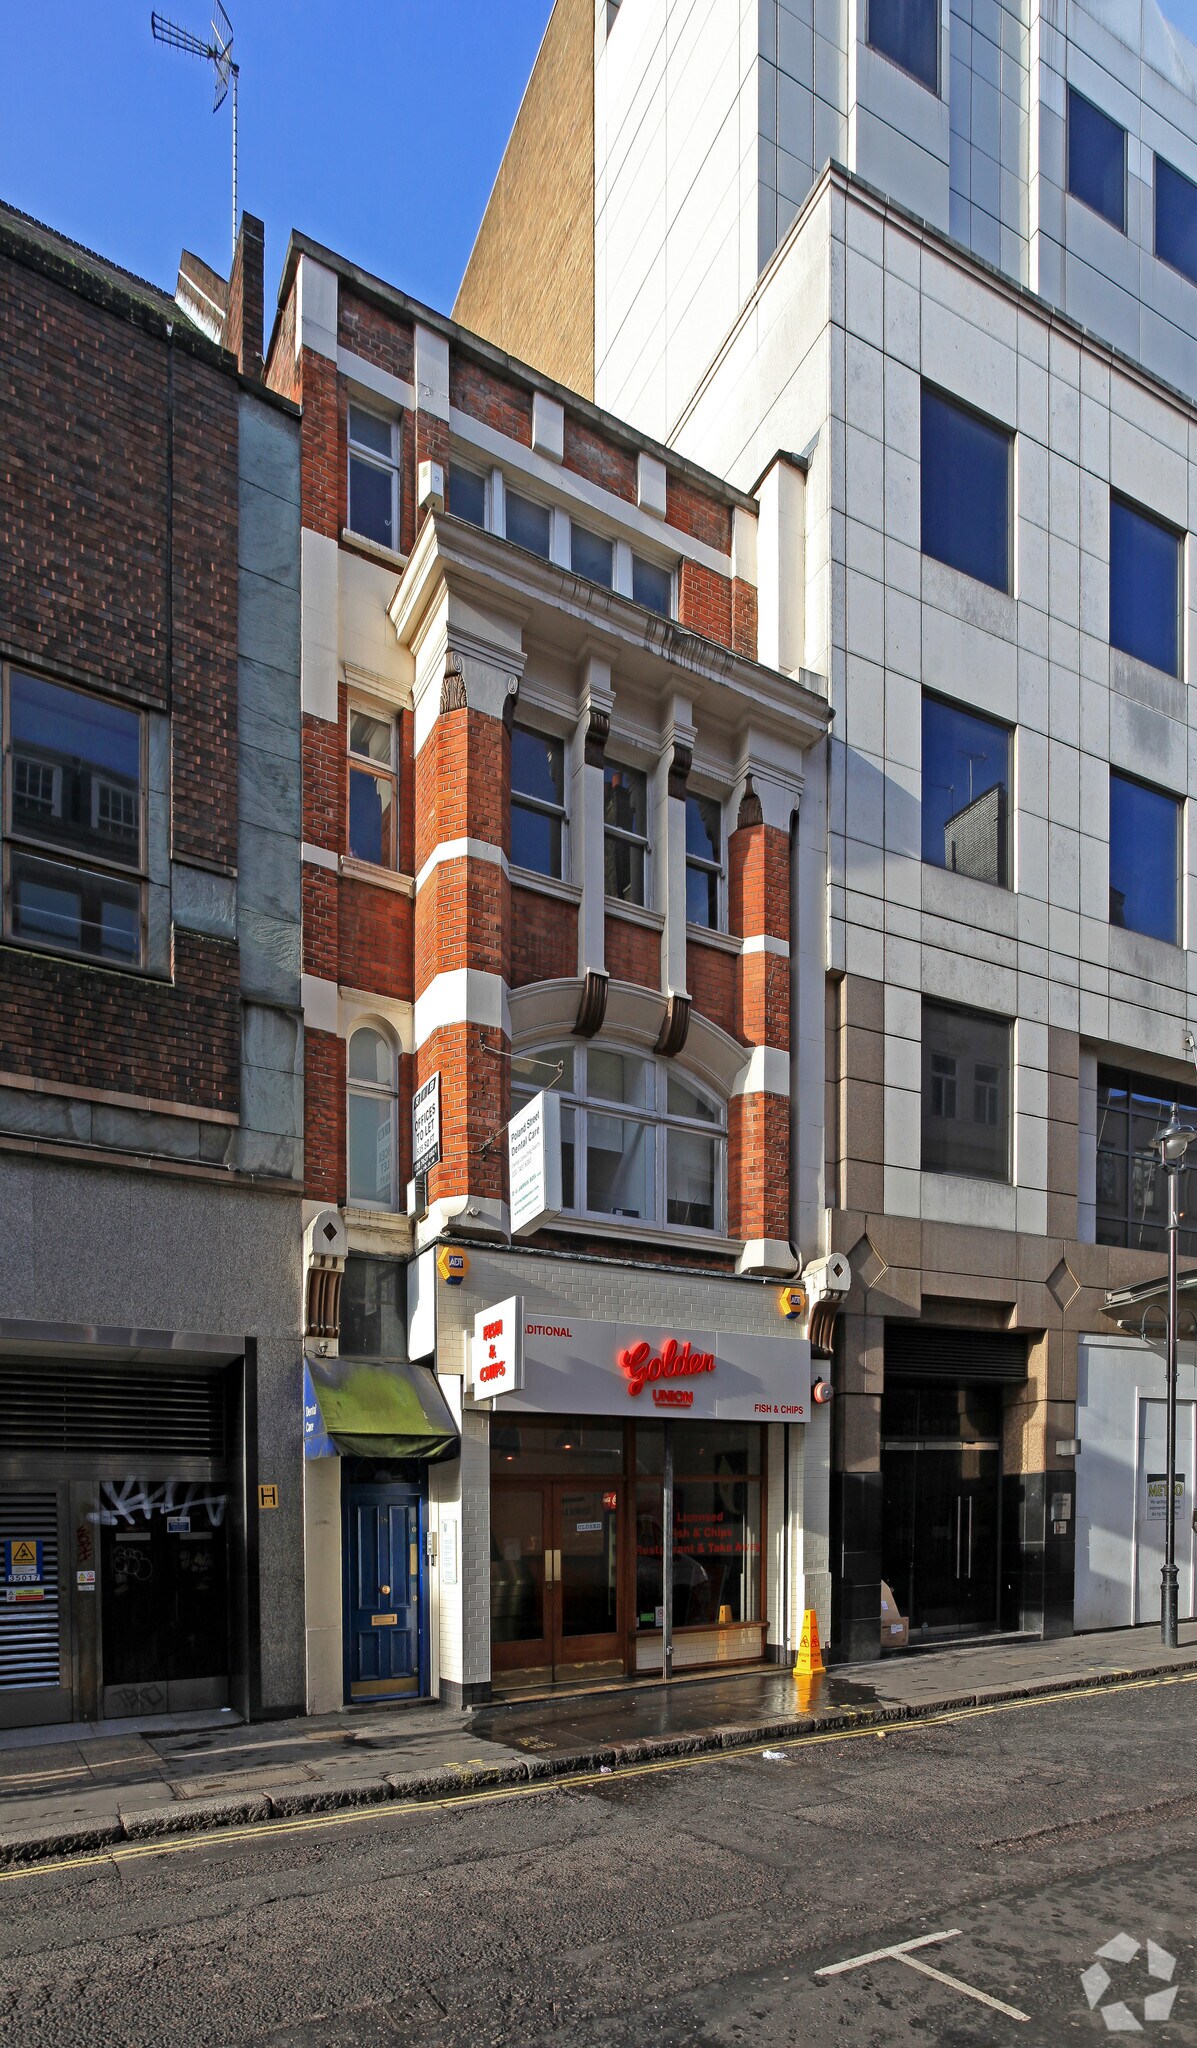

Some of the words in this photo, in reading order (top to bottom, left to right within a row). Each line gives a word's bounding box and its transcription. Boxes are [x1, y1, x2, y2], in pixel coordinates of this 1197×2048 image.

[414, 1103, 436, 1132] OFFICES
[416, 1129, 424, 1143] TO
[425, 1118, 435, 1136] LET
[511, 1122, 526, 1143] Poland
[526, 1110, 539, 1129] Street
[511, 1136, 528, 1157] Dental
[528, 1126, 540, 1141] Care
[450, 1257, 463, 1265] ADT
[483, 1319, 503, 1341] FISH
[489, 1344, 497, 1359] &
[480, 1361, 505, 1382] CHIPS
[620, 1339, 716, 1396] Golden
[652, 1389, 693, 1403] UNION
[306, 1404, 317, 1417] Dental
[754, 1404, 772, 1413] FISH
[773, 1404, 779, 1413] &
[781, 1405, 804, 1414] CHIPS
[306, 1422, 314, 1432] Care
[261, 1487, 276, 1505] H
[1148, 1483, 1183, 1497] METO
[676, 1511, 724, 1522] Licensed
[673, 1528, 690, 1538] ish
[693, 1528, 700, 1537] &
[703, 1527, 732, 1539] Chips
[697, 1543, 704, 1553] &
[708, 1543, 732, 1553] Take
[9, 1574, 40, 1582] 35017
